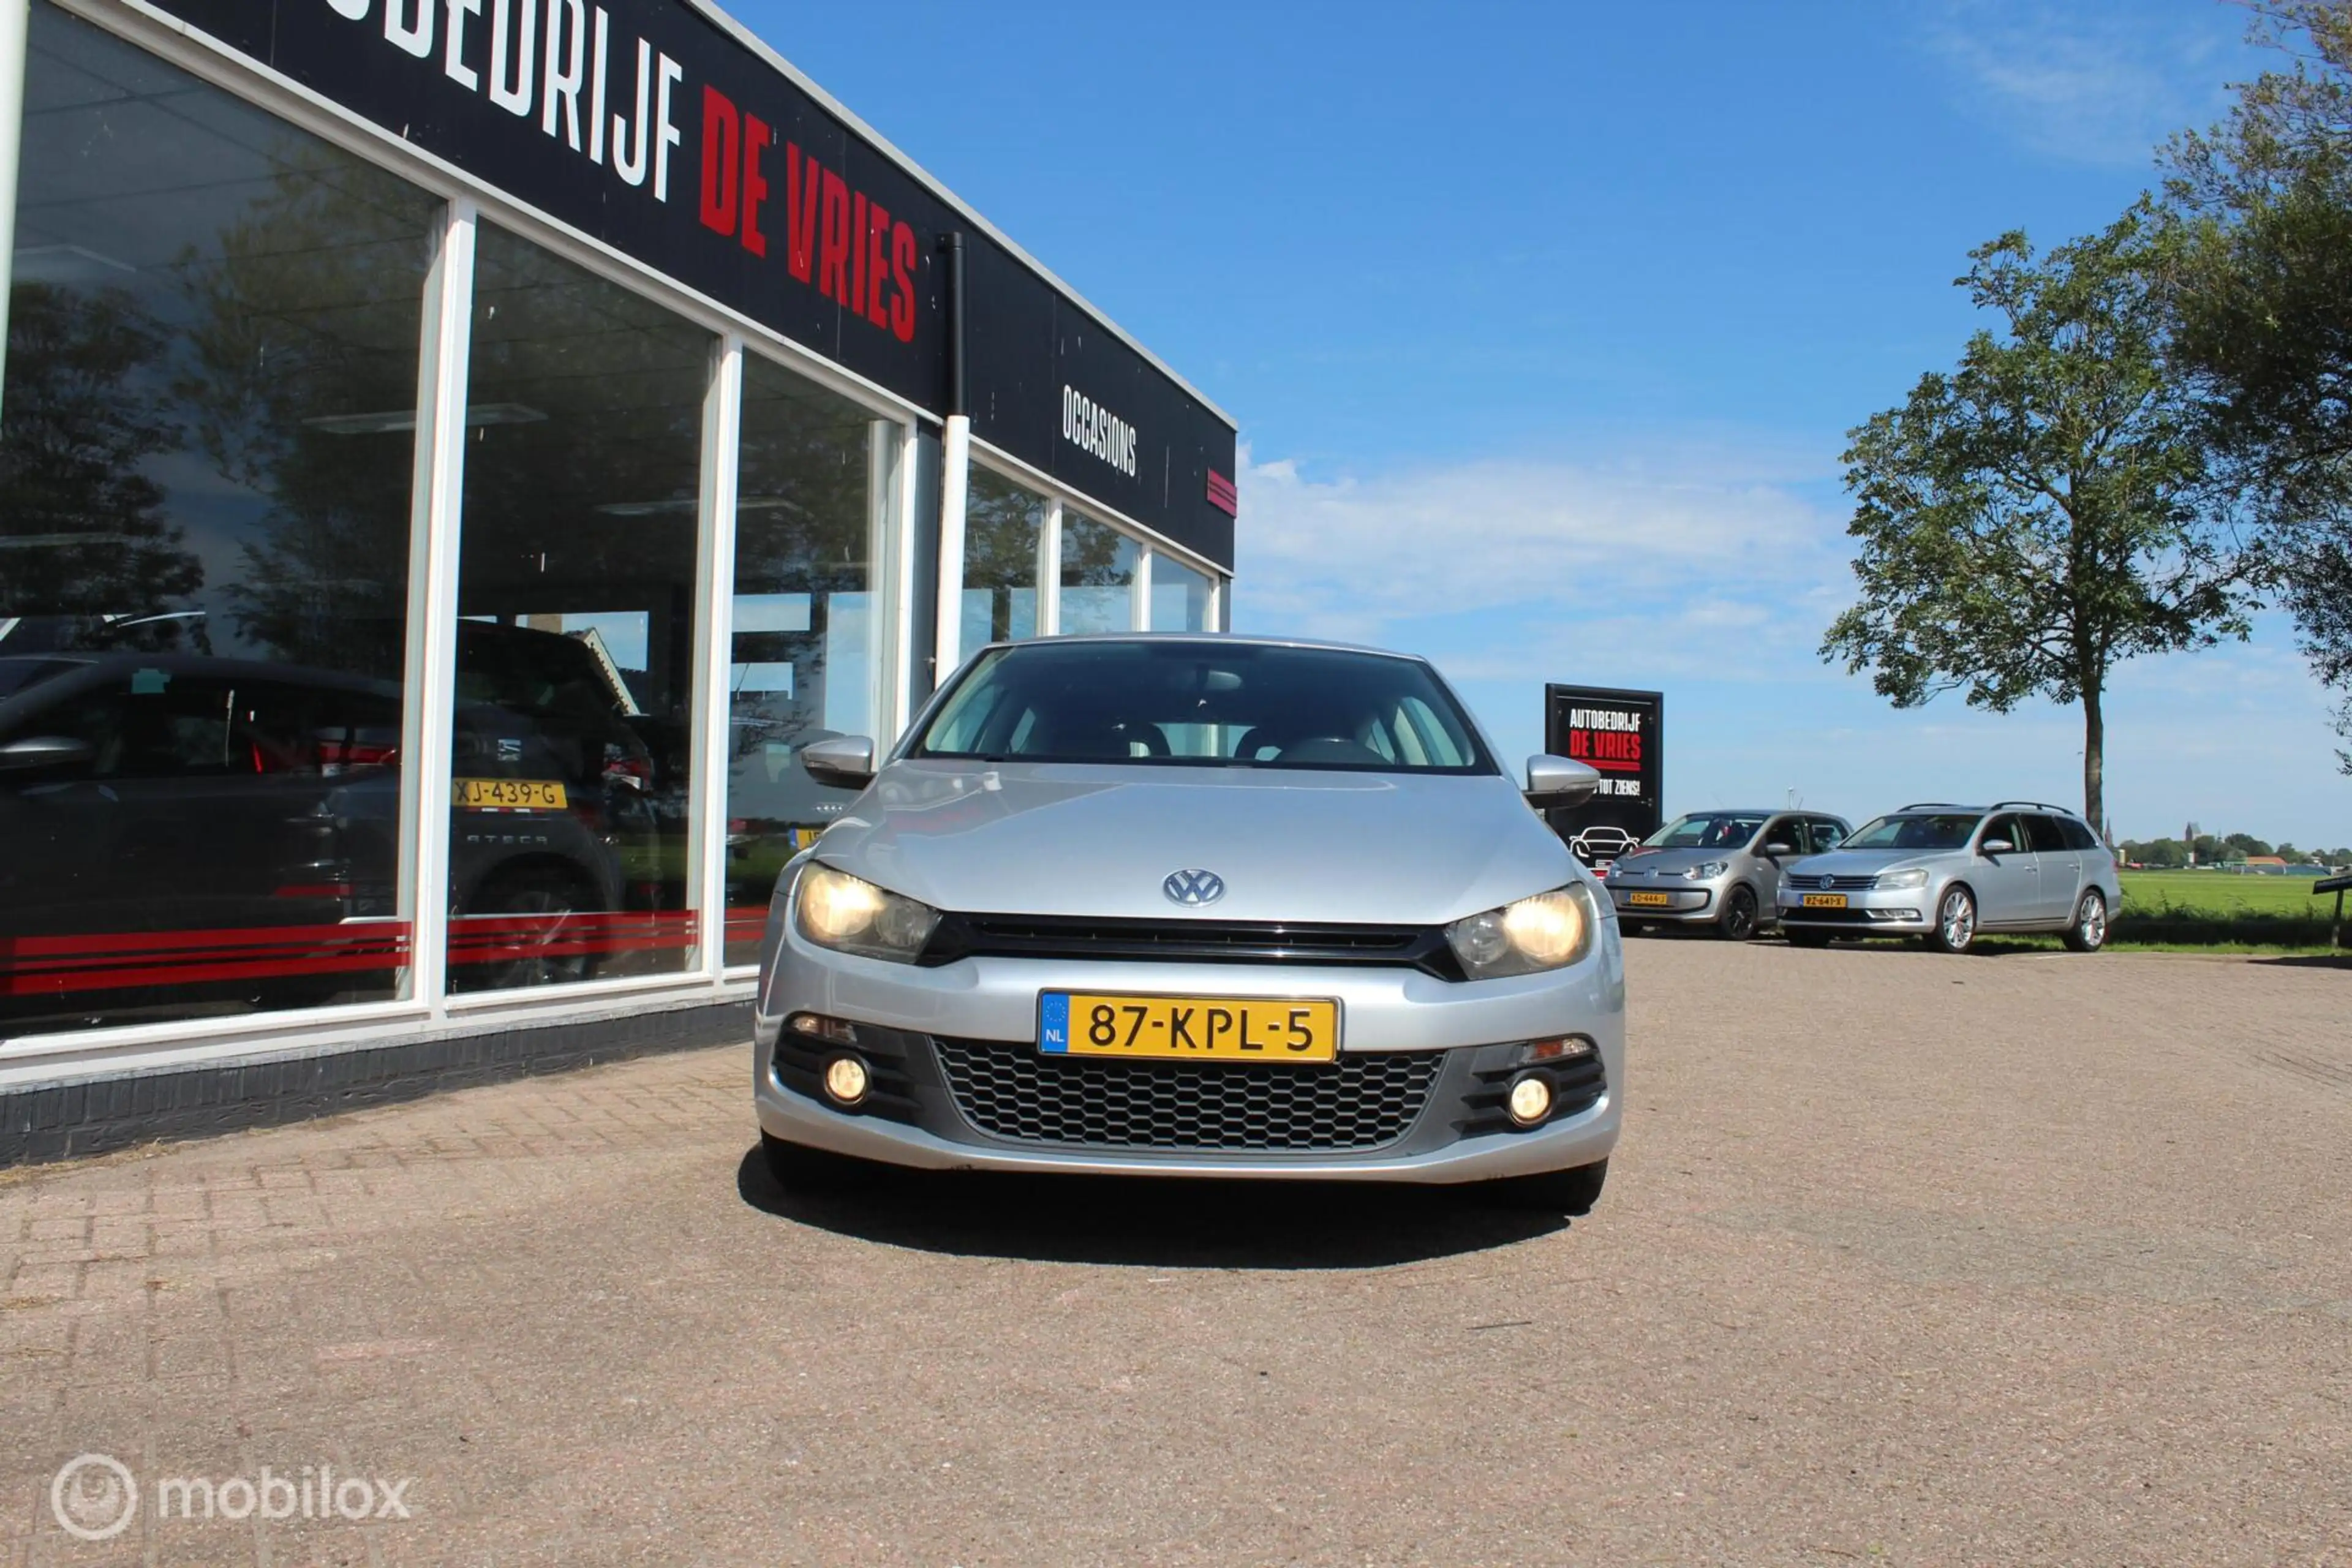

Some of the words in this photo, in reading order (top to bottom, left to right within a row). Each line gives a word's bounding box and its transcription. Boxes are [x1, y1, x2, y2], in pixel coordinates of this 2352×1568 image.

[326, 0, 682, 203] EDRIJF
[699, 84, 770, 258] DE
[786, 141, 916, 343] VRIES
[1063, 385, 1136, 477] OCCASIONS
[1569, 708, 1641, 732] AUTOBEDRIJF
[1570, 729, 1589, 756] DE
[1594, 731, 1641, 760] VRIES
[455, 782, 555, 804] XJ-439-G
[1599, 778, 1613, 794] TOT
[1615, 779, 1640, 796] ZIENS!
[1046, 1029, 1064, 1042] NL
[1088, 1005, 1313, 1051] 87-KPL-5
